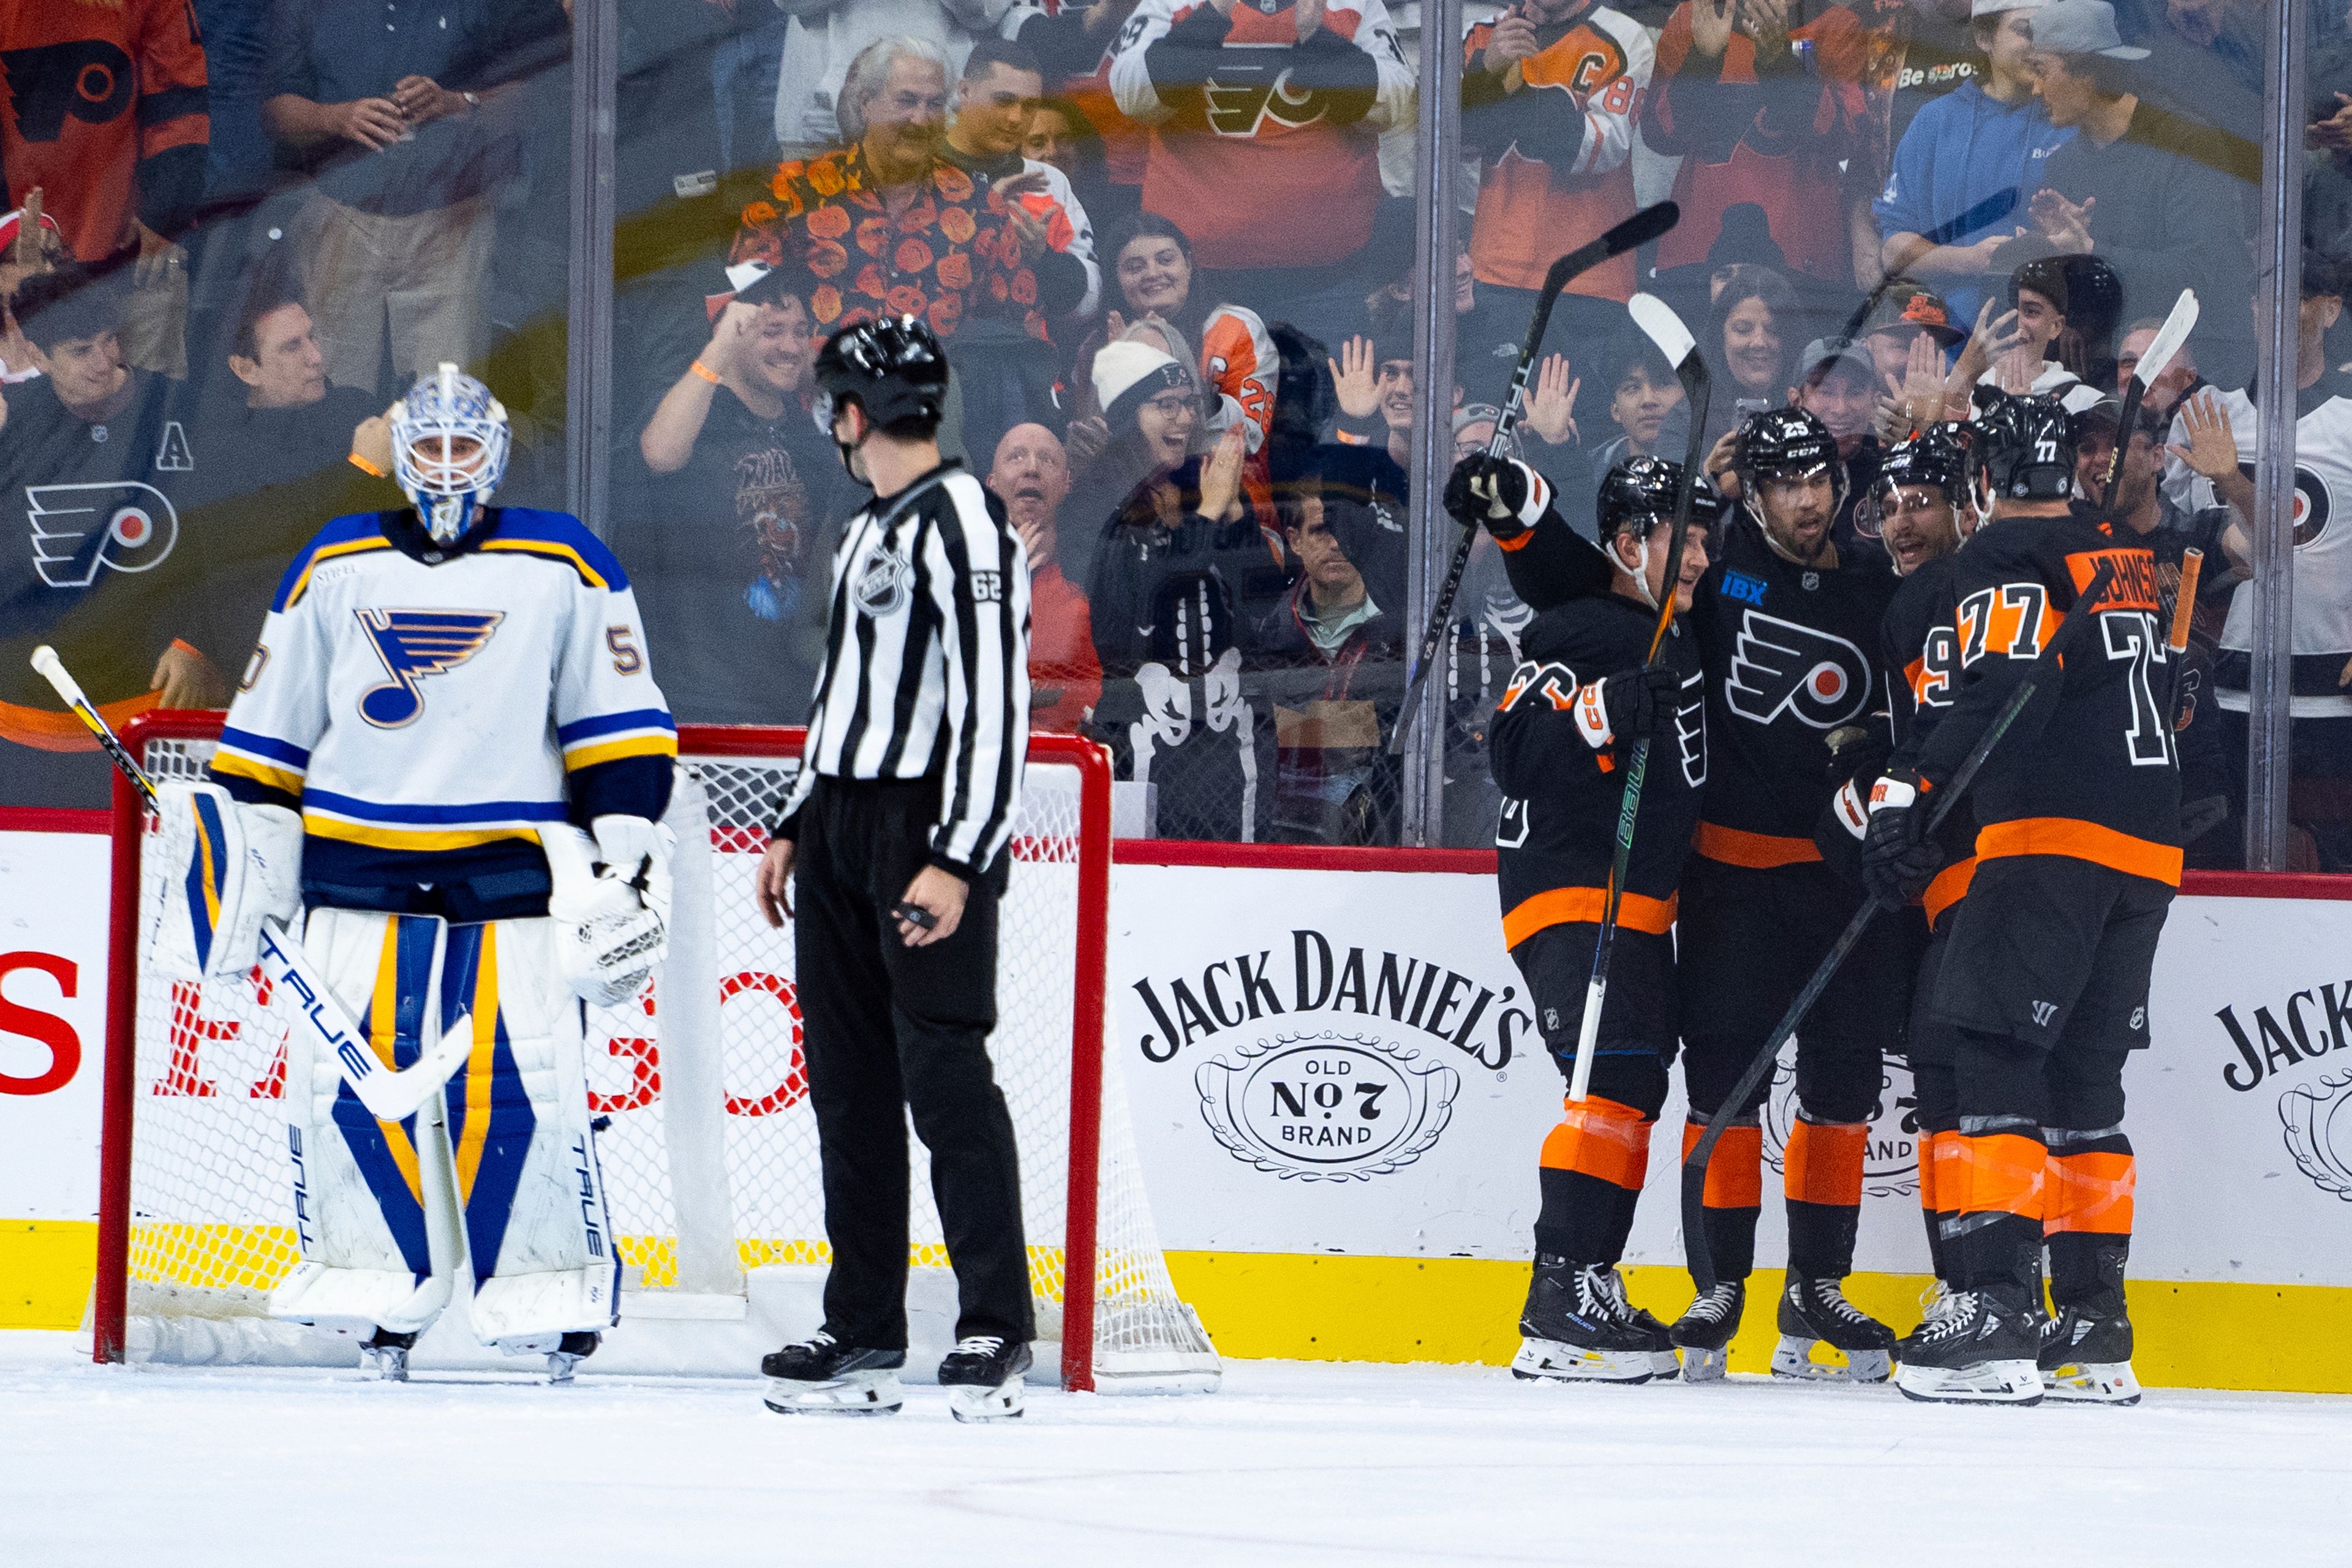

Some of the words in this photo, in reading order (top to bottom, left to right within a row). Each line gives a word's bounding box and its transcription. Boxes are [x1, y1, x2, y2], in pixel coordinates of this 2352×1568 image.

[1571, 51, 1606, 93] C
[1489, 358, 1534, 459] TRUE
[1782, 421, 1809, 439] 25
[156, 421, 194, 471] A
[2035, 440, 2057, 462] 77
[973, 571, 1002, 601] 62
[1720, 575, 1767, 606] IBX
[1959, 583, 2046, 670] 77
[605, 624, 644, 676] 5
[262, 930, 373, 1081] TRUE
[1132, 949, 1287, 1063] JACK
[1290, 930, 1534, 1071] DANIEL'S
[1305, 1060, 1351, 1076] OLD
[1354, 1083, 1388, 1119] 7
[1281, 1125, 1373, 1148] BRAND
[289, 1124, 314, 1253] TRUE
[571, 1133, 605, 1257] TRUE
